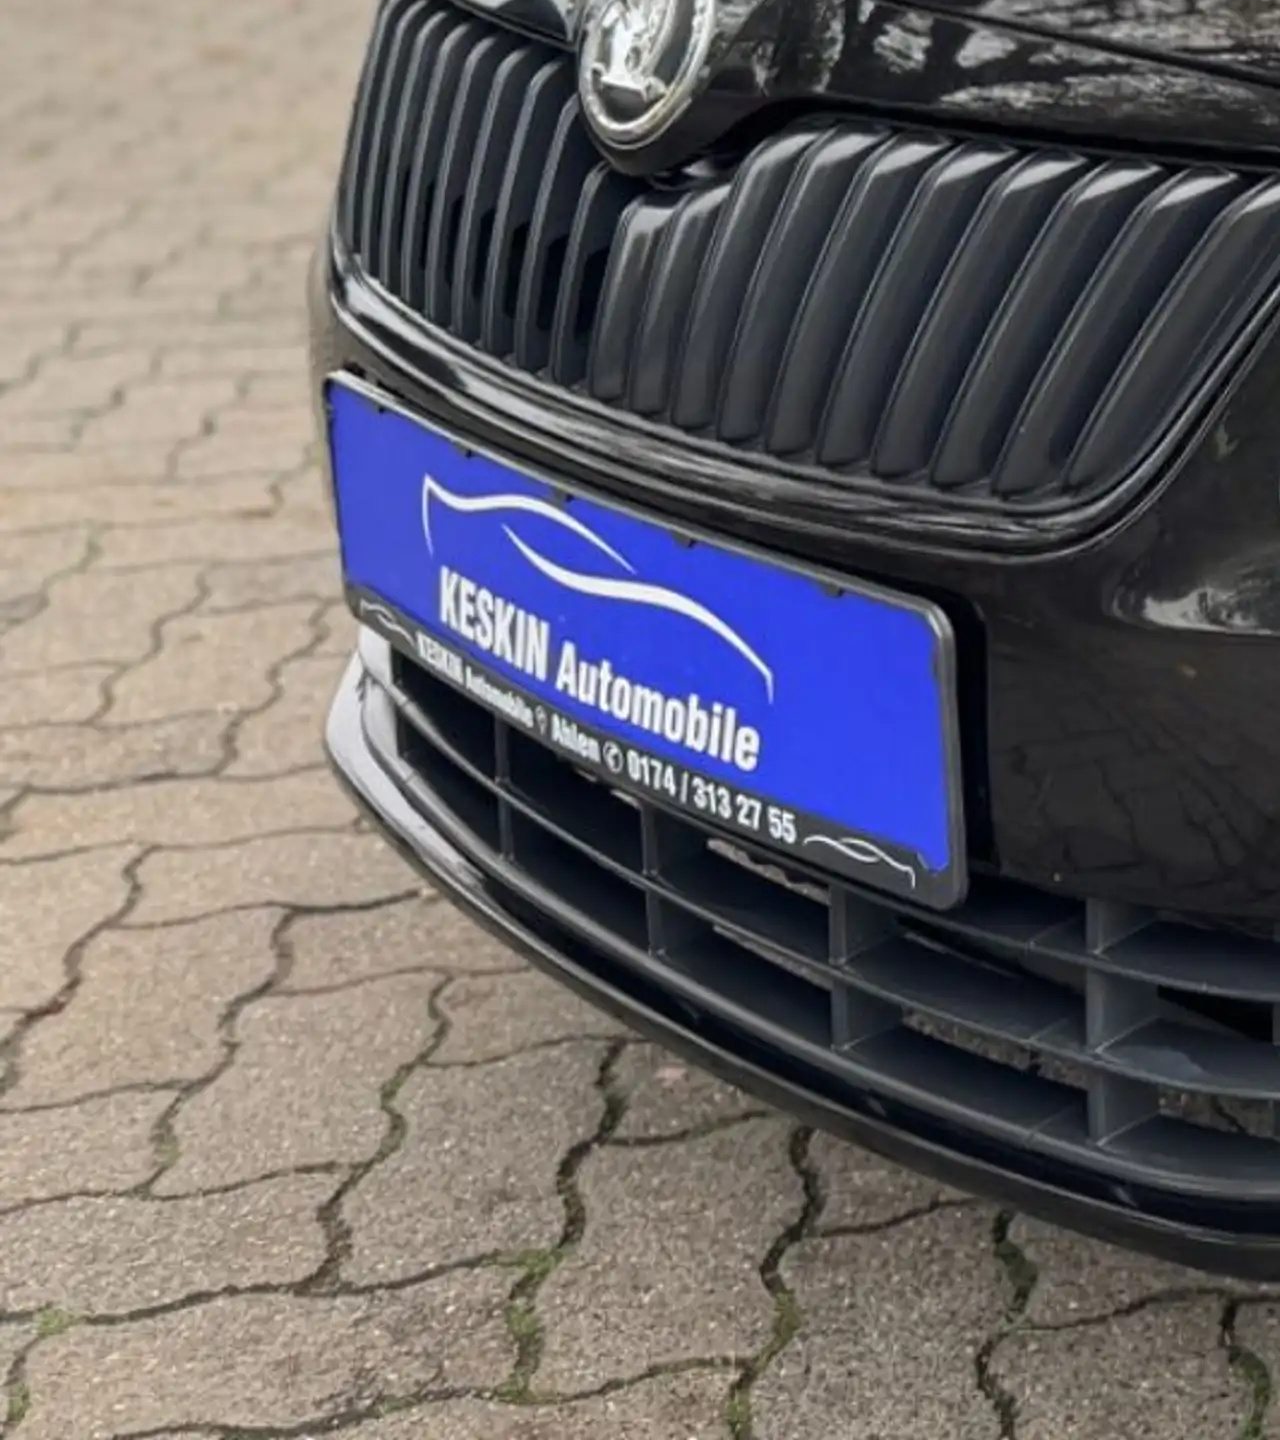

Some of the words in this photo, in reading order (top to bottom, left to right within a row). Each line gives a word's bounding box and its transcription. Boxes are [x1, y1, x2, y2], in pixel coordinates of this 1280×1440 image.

[440, 565, 550, 682] KESKIN
[555, 640, 760, 772] Automobile
[552, 713, 601, 762] Ahlen
[626, 749, 676, 797] 0174
[691, 776, 733, 819] 313
[736, 794, 763, 831] 27
[767, 806, 797, 844] 55
